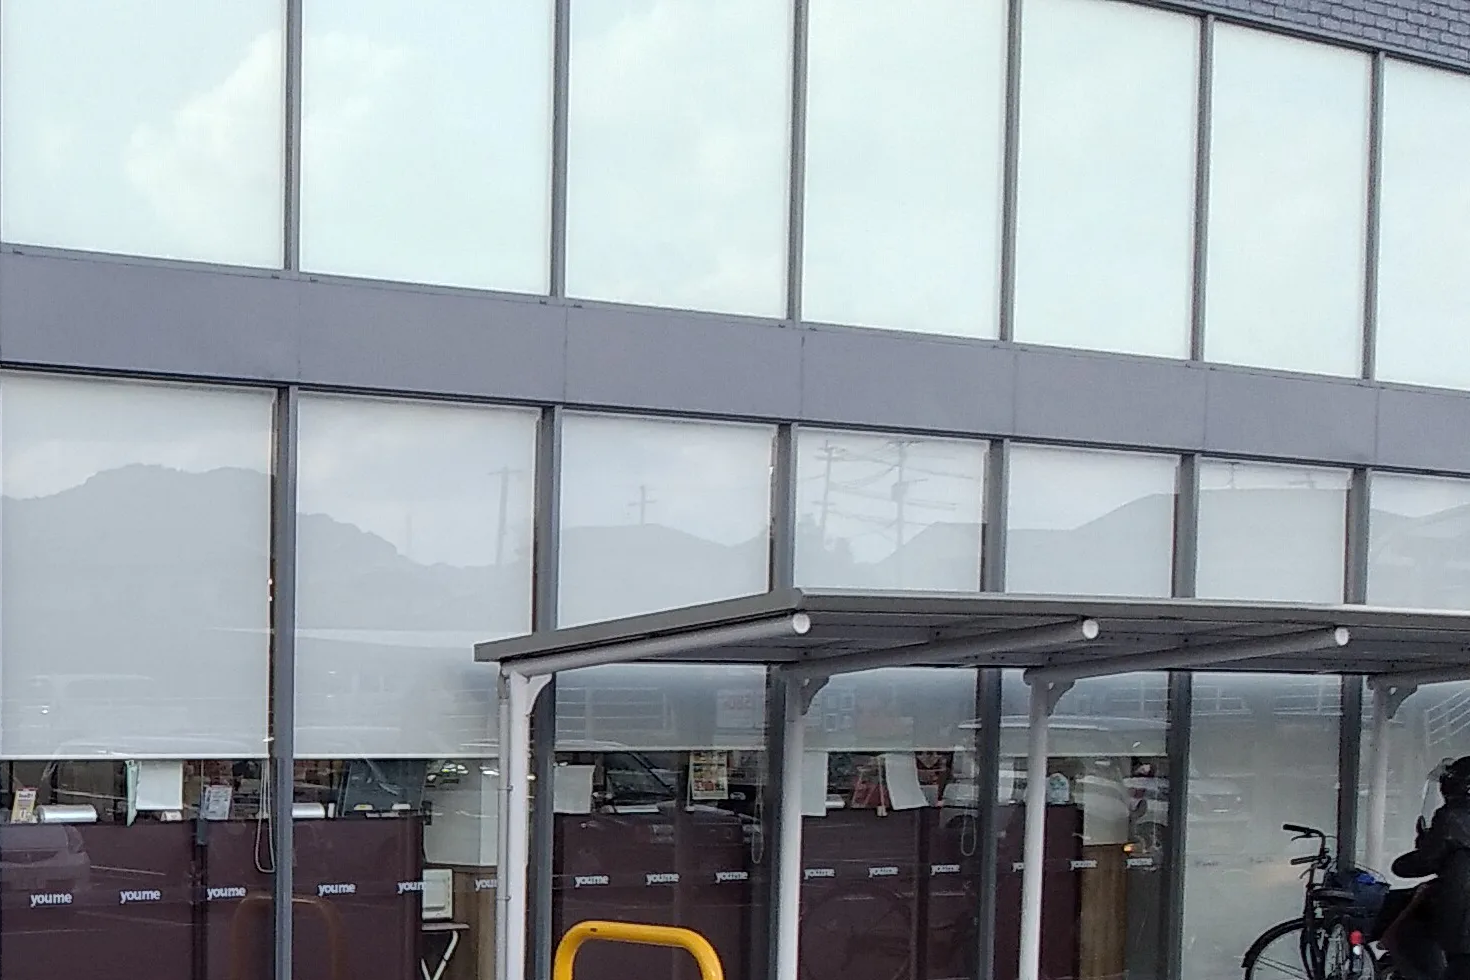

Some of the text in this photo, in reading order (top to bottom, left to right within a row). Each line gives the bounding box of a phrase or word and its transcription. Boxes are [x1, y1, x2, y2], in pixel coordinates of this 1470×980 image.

[804, 868, 835, 880] youme
[868, 866, 898, 878] youme
[931, 864, 960, 876] youme
[574, 875, 609, 888] youme
[646, 873, 679, 885] youme
[715, 871, 748, 883] youme
[207, 886, 246, 900] youme
[318, 883, 356, 897] youme
[30, 892, 72, 908] youme
[120, 889, 161, 904] youme
